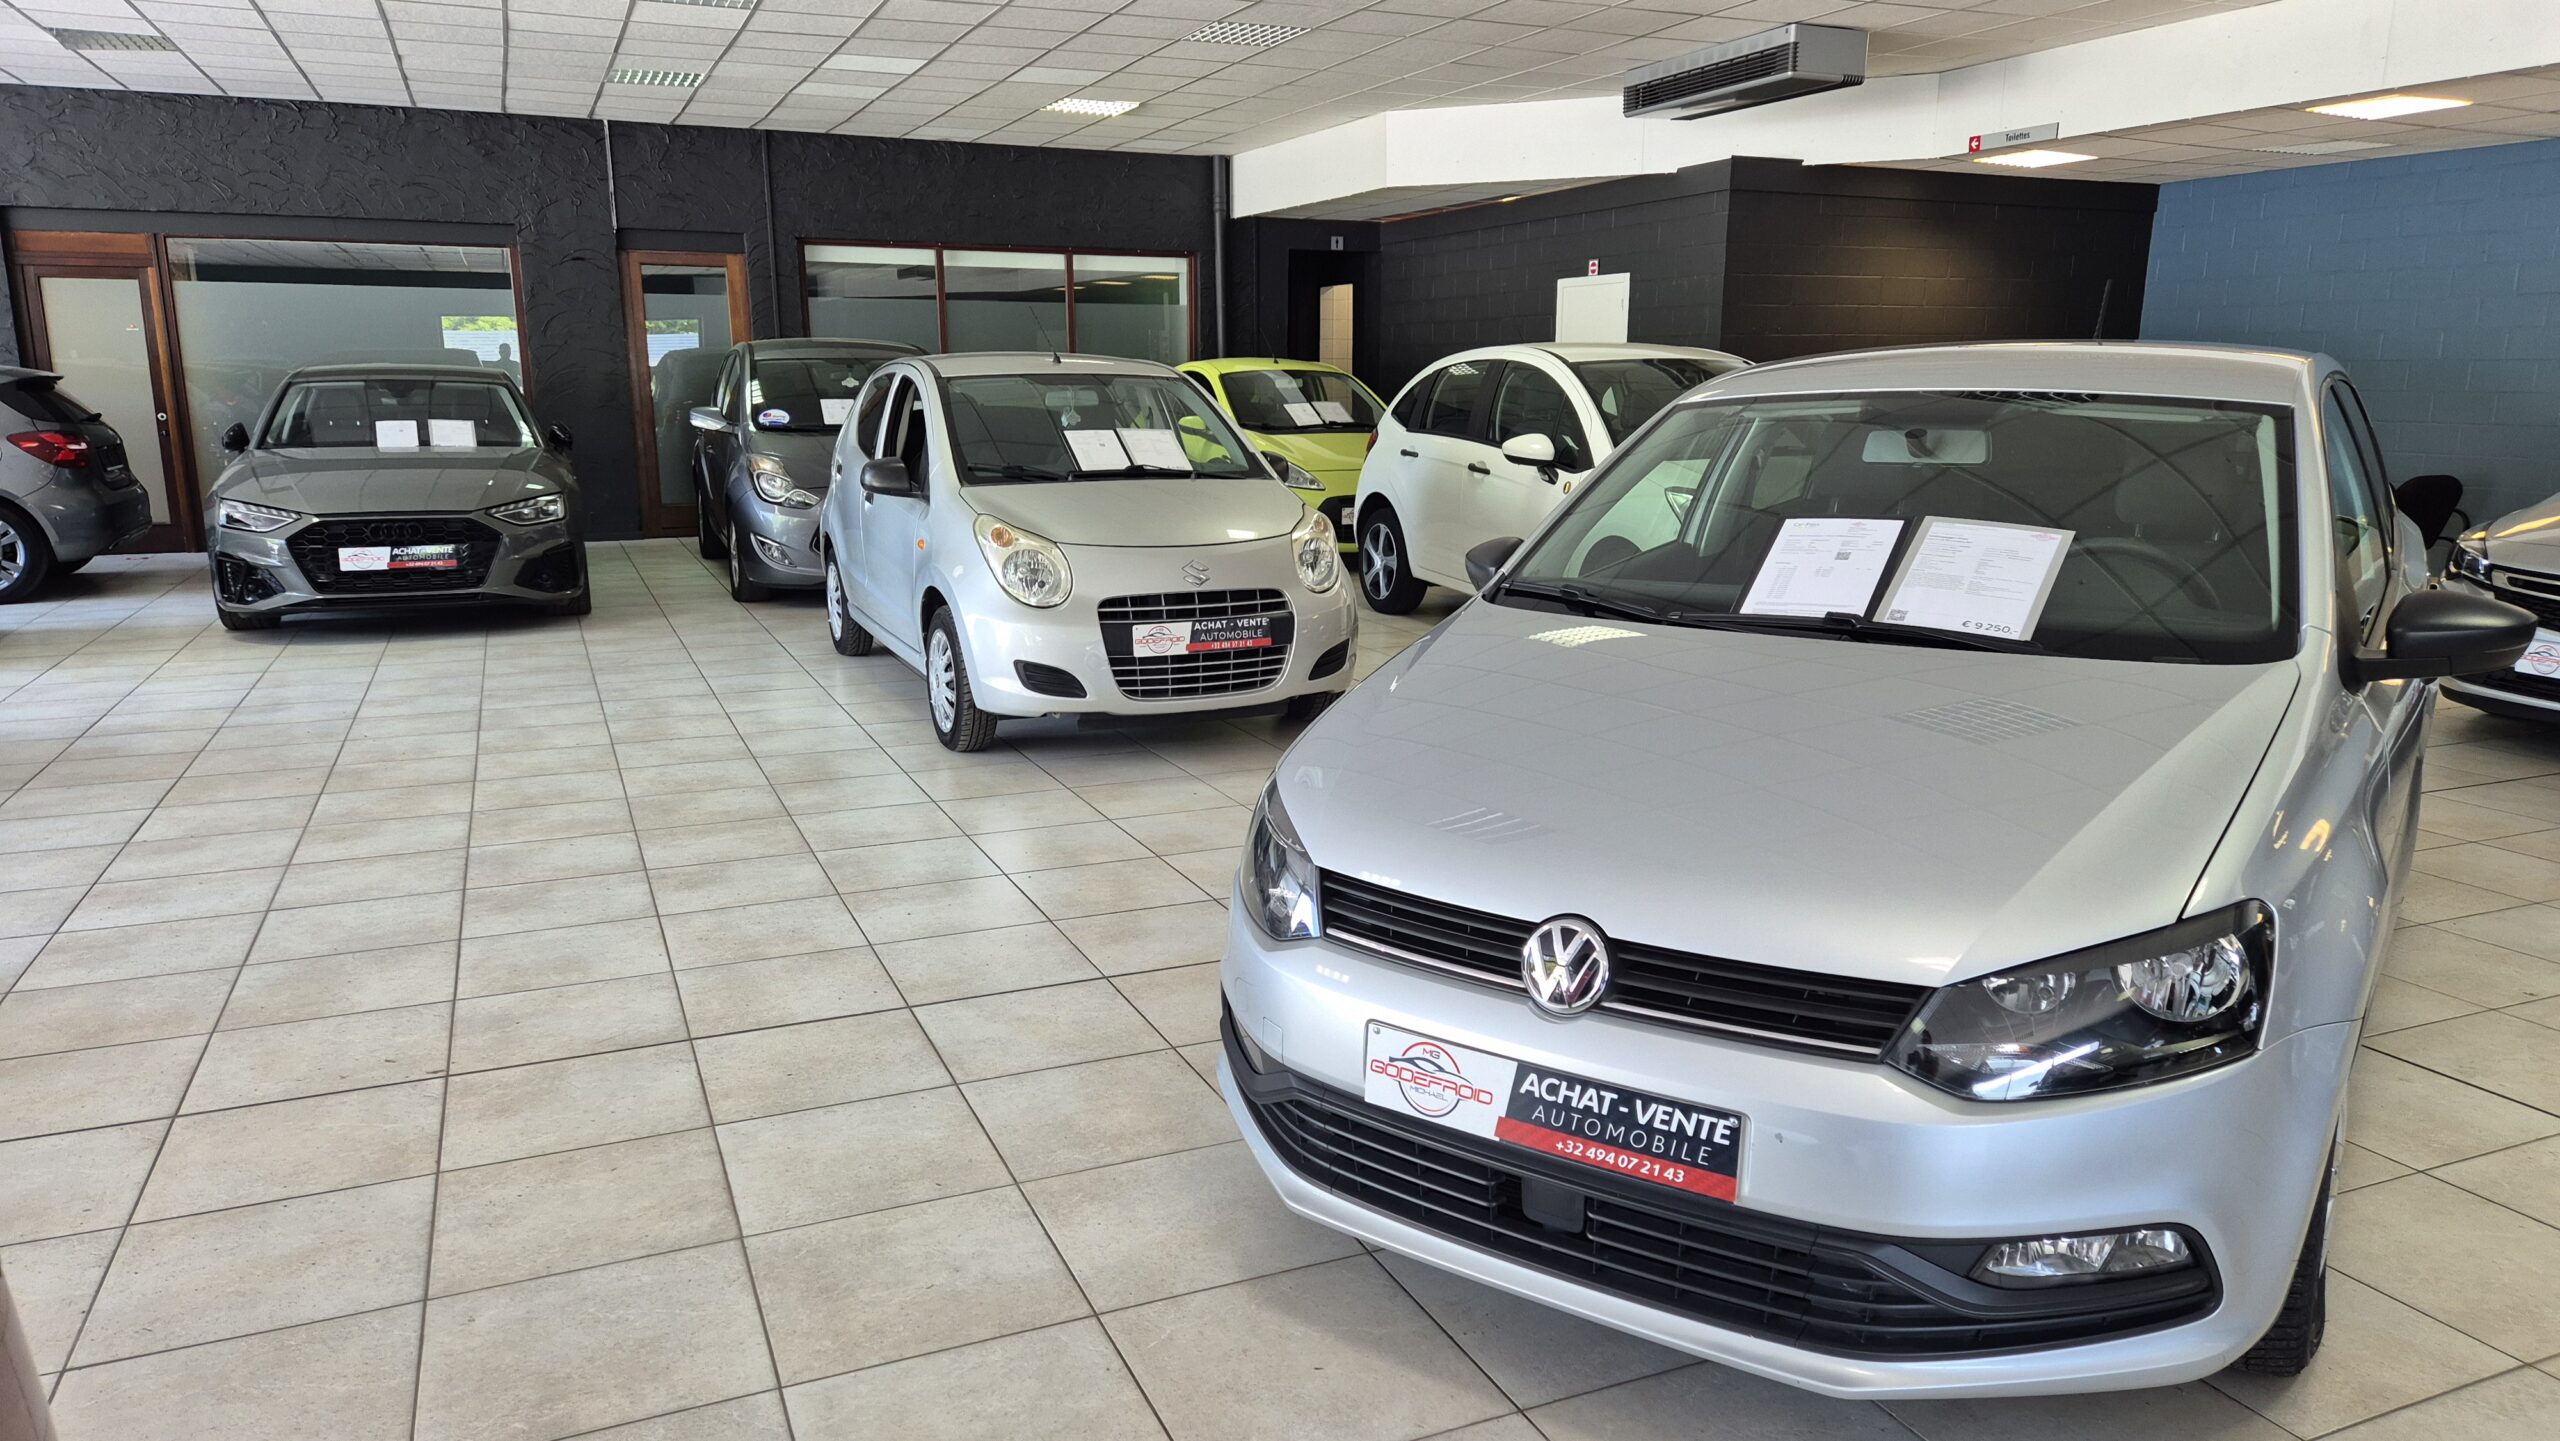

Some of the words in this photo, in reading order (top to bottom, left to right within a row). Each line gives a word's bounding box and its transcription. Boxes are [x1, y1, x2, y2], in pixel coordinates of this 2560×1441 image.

[2005, 131, 2031, 142] Toilettes
[392, 547, 421, 555] ACHAT
[1194, 621, 1228, 631] ACHAT
[1237, 618, 1268, 627] VENTE
[1200, 629, 1263, 641] AUTOMOBILE
[1422, 1047, 1441, 1060] MG
[1370, 1058, 1494, 1106] GODEFROID
[1519, 1072, 1619, 1116] ACHAT
[1635, 1098, 1731, 1146] VENTE
[1531, 1104, 1713, 1166] AUTOMOBILE
[1555, 1140, 1584, 1157] +32
[1585, 1147, 1616, 1165] 494
[1617, 1155, 1640, 1170] 07
[1639, 1160, 1661, 1177] 21
[1663, 1167, 1685, 1183] 43
